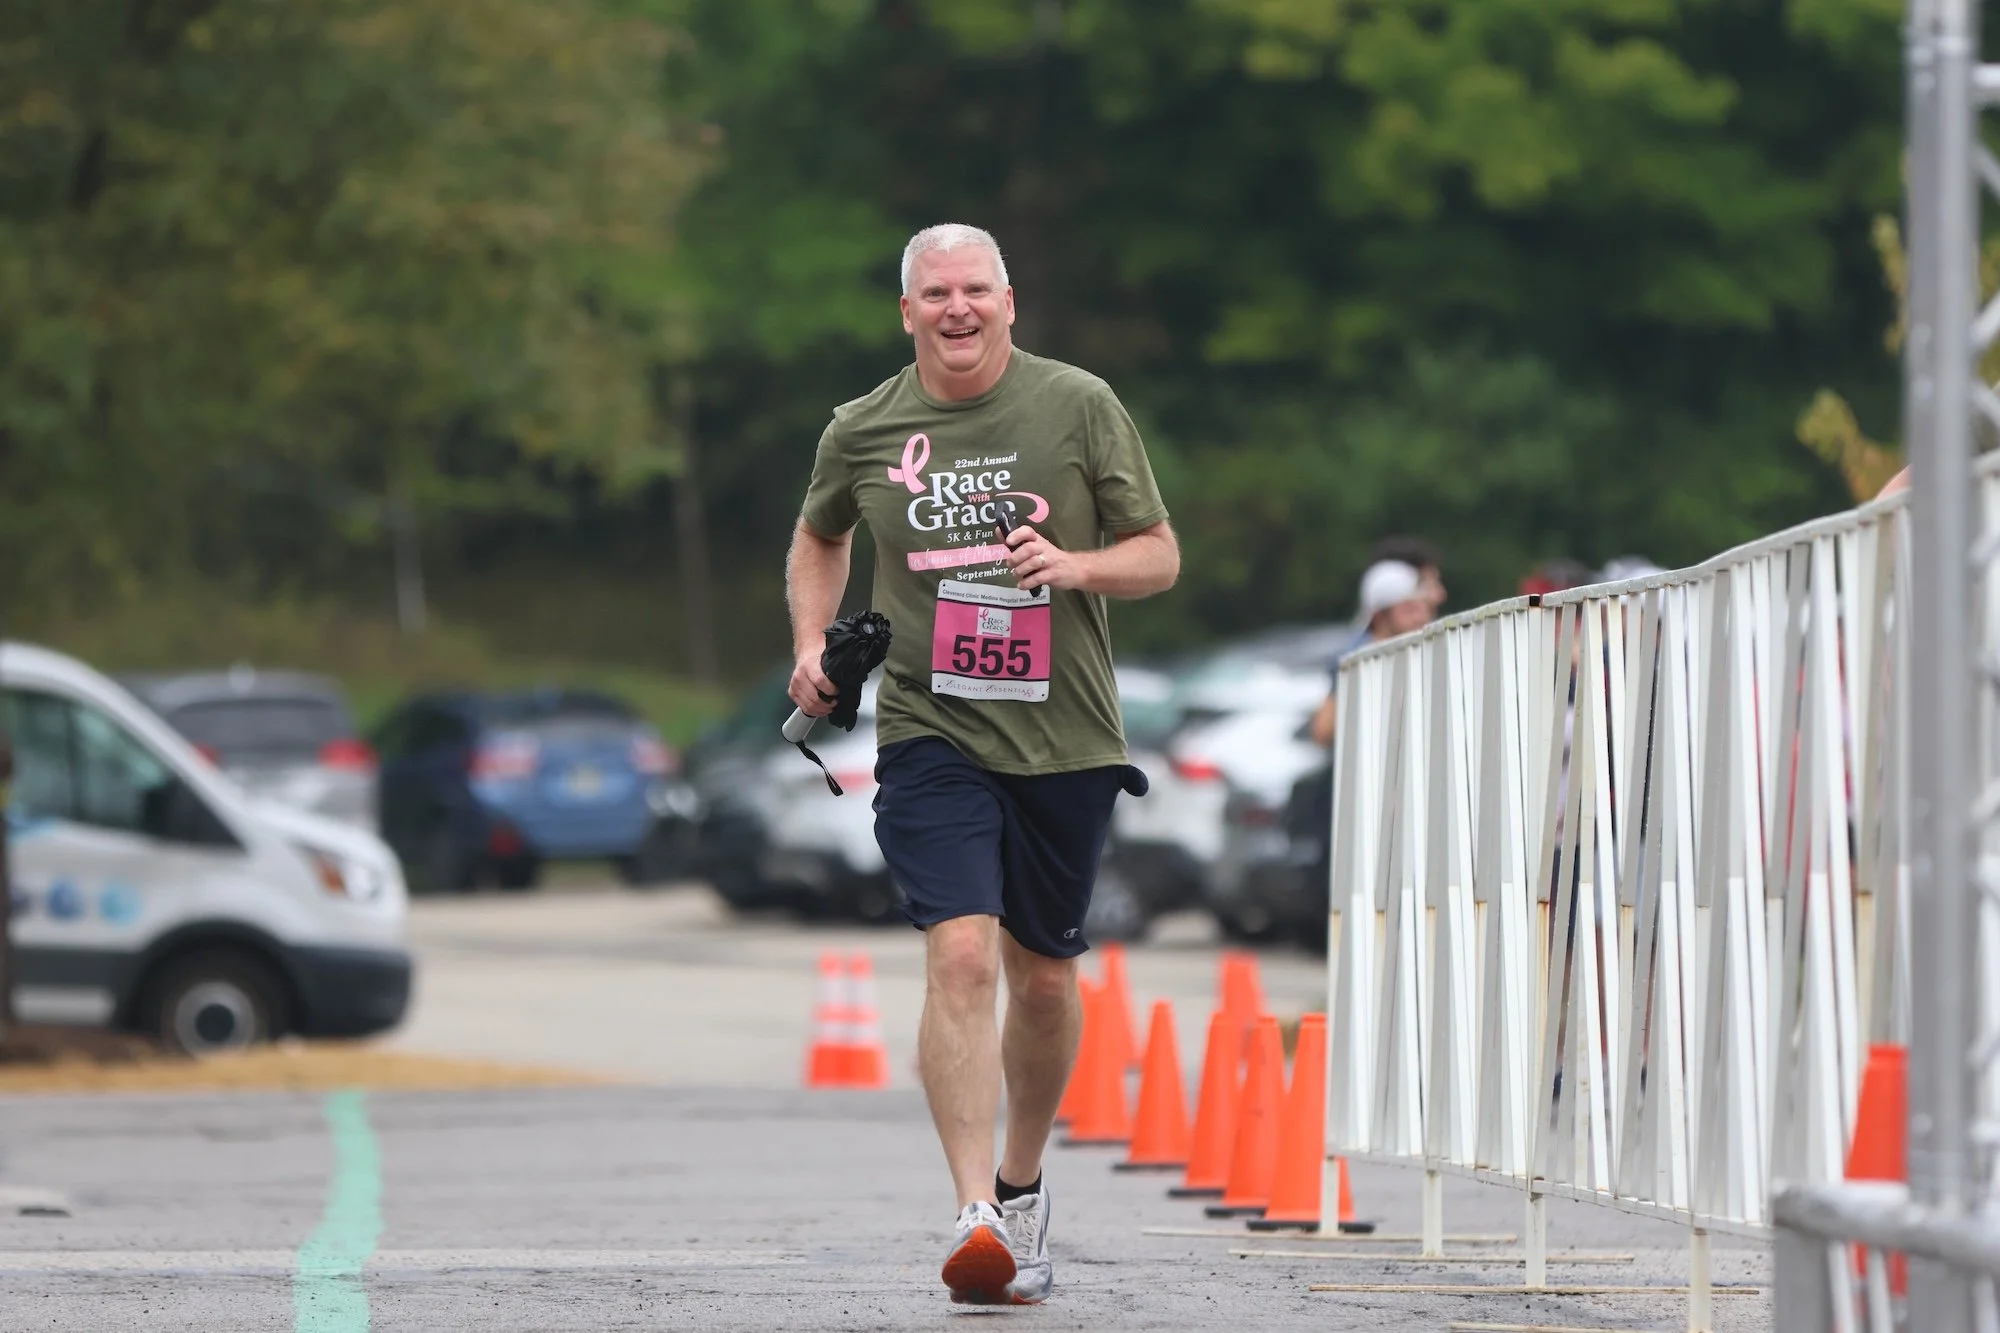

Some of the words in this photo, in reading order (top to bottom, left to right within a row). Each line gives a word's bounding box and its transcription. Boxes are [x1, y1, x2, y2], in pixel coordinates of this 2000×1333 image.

[954, 457, 980, 469] 22nd
[982, 452, 1018, 467] Annual
[928, 469, 1012, 508] Race
[967, 493, 991, 504] With
[947, 533, 961, 544] 5K
[963, 530, 973, 540] &
[975, 529, 994, 540] Fun
[956, 568, 1009, 582] September
[942, 589, 965, 599] Cleveland
[982, 621, 1005, 630] Grace
[988, 617, 1004, 625] Race
[952, 634, 1031, 677] 555
